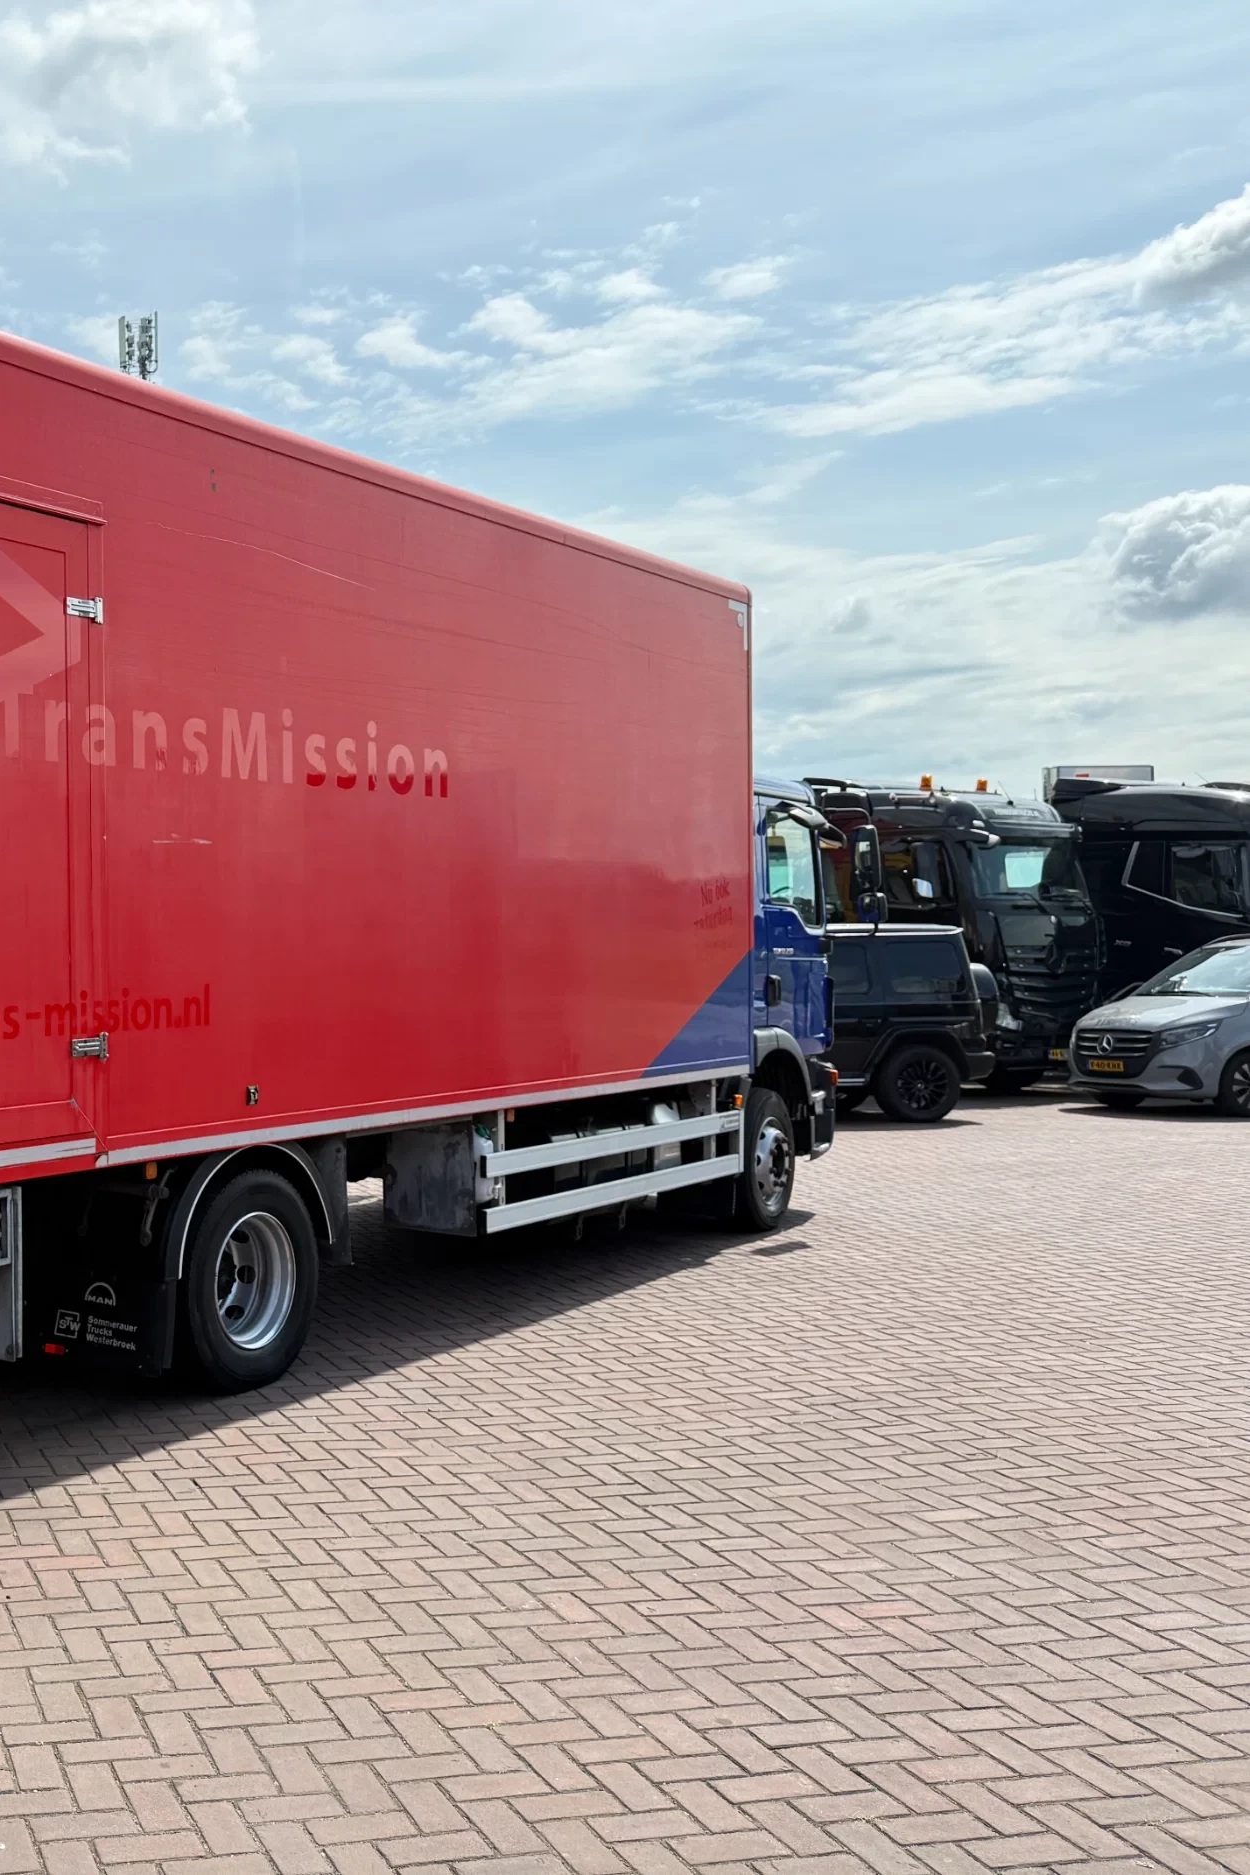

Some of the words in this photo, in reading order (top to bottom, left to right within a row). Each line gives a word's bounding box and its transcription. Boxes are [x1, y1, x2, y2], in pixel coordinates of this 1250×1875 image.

[0, 686, 449, 799] TransMission
[87, 1295, 113, 1306] MAN
[58, 1316, 81, 1332] STW
[87, 1323, 112, 1337] Trucks
[88, 1315, 138, 1332] Sommerauer
[86, 1333, 136, 1351] Westerbroek
